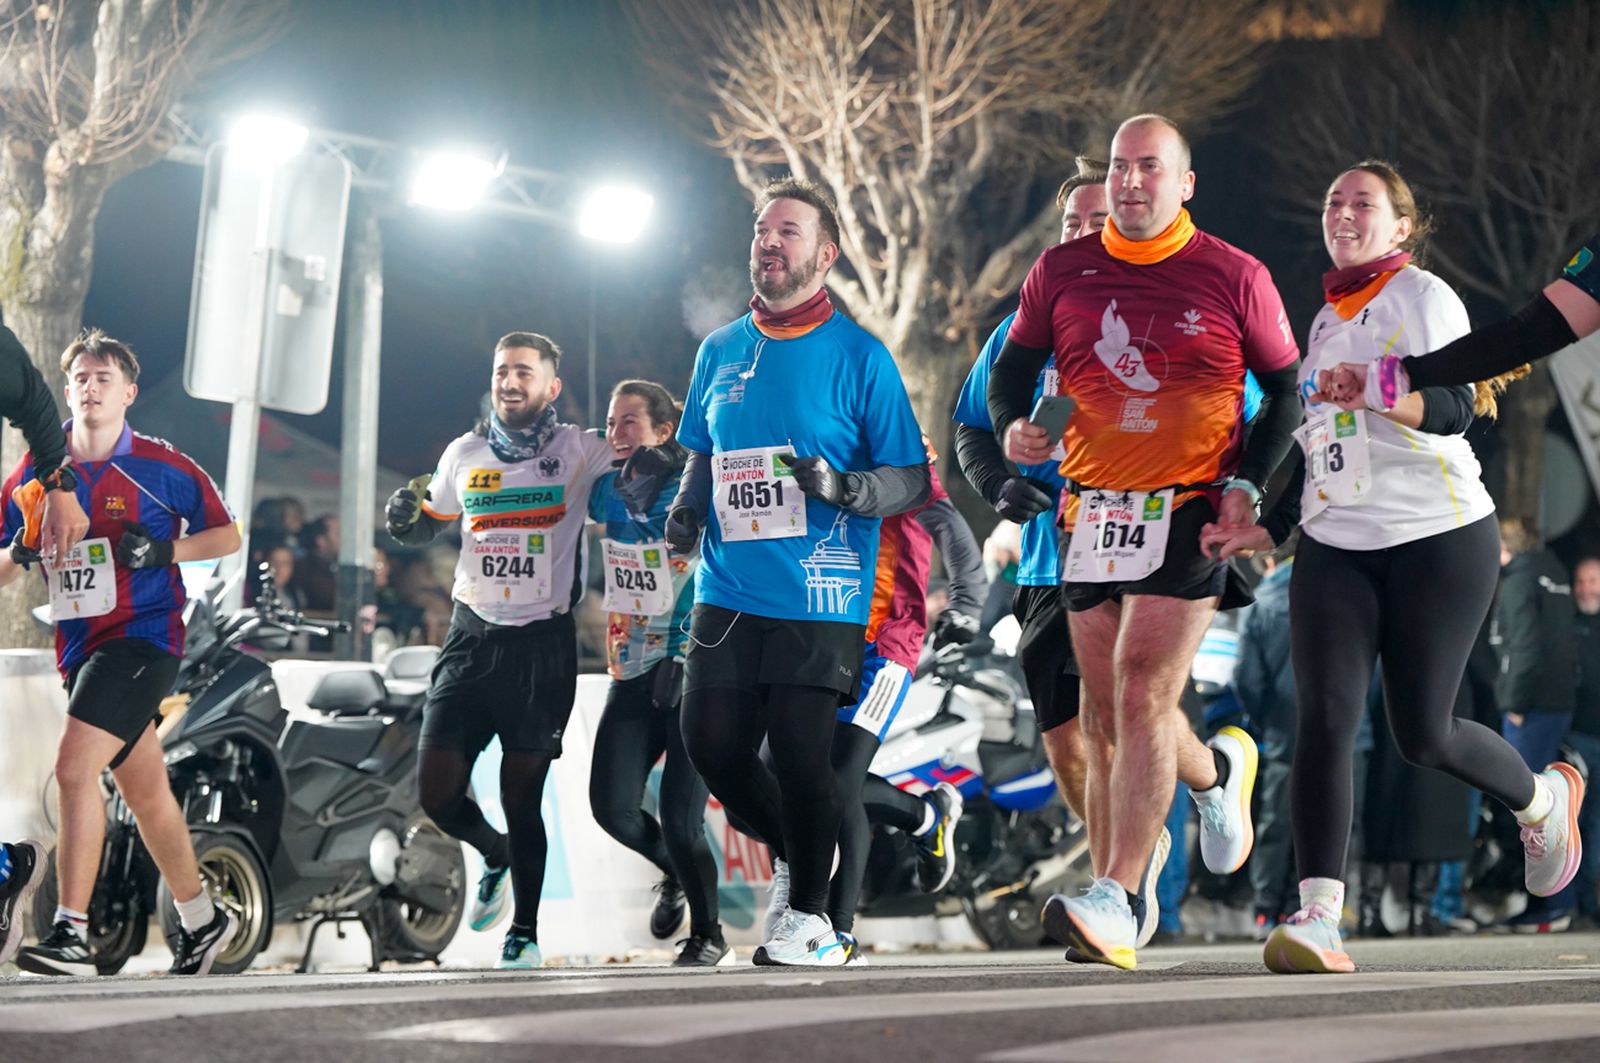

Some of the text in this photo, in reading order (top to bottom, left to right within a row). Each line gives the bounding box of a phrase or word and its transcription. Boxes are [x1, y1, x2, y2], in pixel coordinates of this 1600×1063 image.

[1114, 353, 1142, 377] 43
[1122, 408, 1147, 419] SAN
[729, 460, 752, 471] NOCHE
[753, 458, 764, 468] DE
[722, 473, 735, 483] SAN
[736, 467, 765, 481] ANTÓN
[464, 491, 554, 509] CARRERA
[728, 480, 784, 510] 4651
[510, 536, 521, 545] DE
[474, 546, 491, 554] SAN
[492, 545, 520, 554] ANTÓN
[482, 555, 536, 578] 6244
[615, 567, 657, 592] 6243
